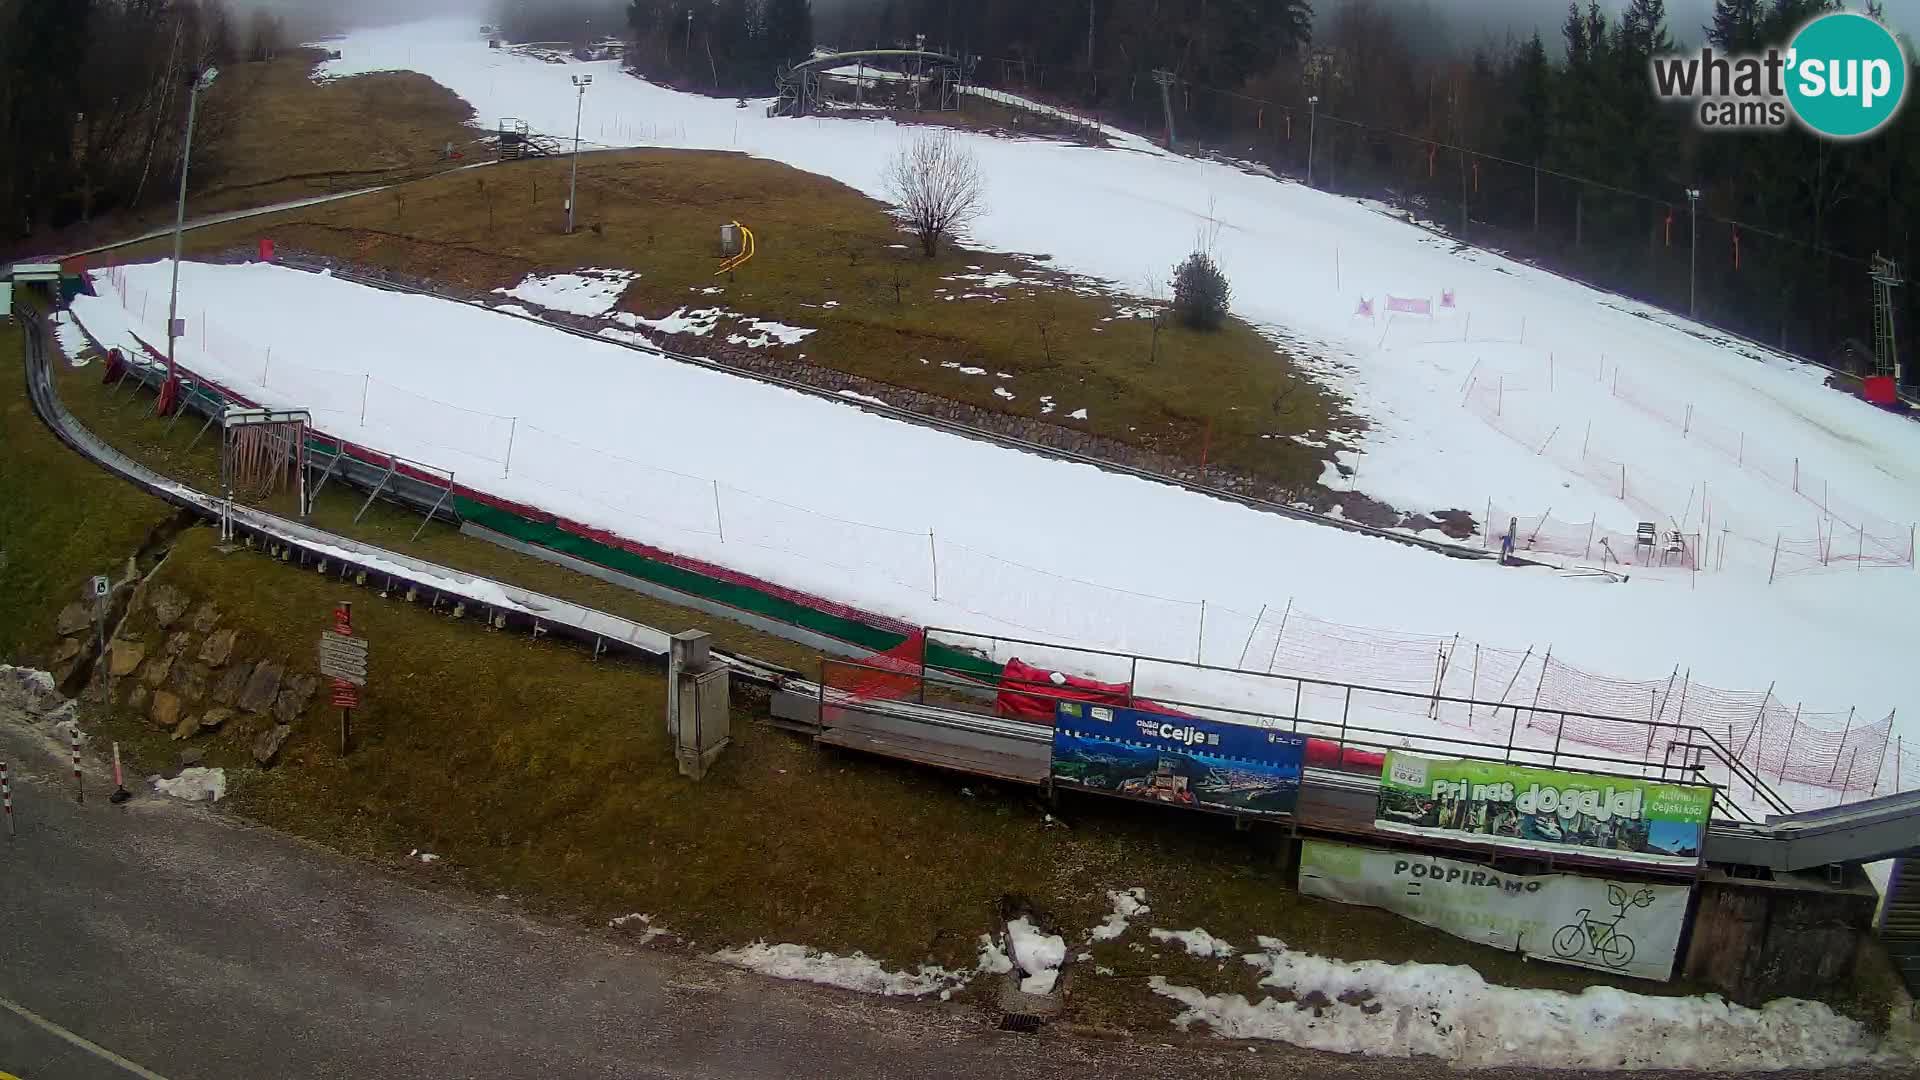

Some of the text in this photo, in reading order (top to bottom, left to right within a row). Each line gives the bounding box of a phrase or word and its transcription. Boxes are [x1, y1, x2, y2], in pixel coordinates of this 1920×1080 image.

[1160, 724, 1205, 745] Celje
[1431, 779, 1467, 801] Pri
[1472, 781, 1514, 802] nas
[1394, 860, 1542, 893] PODPIRAMO
